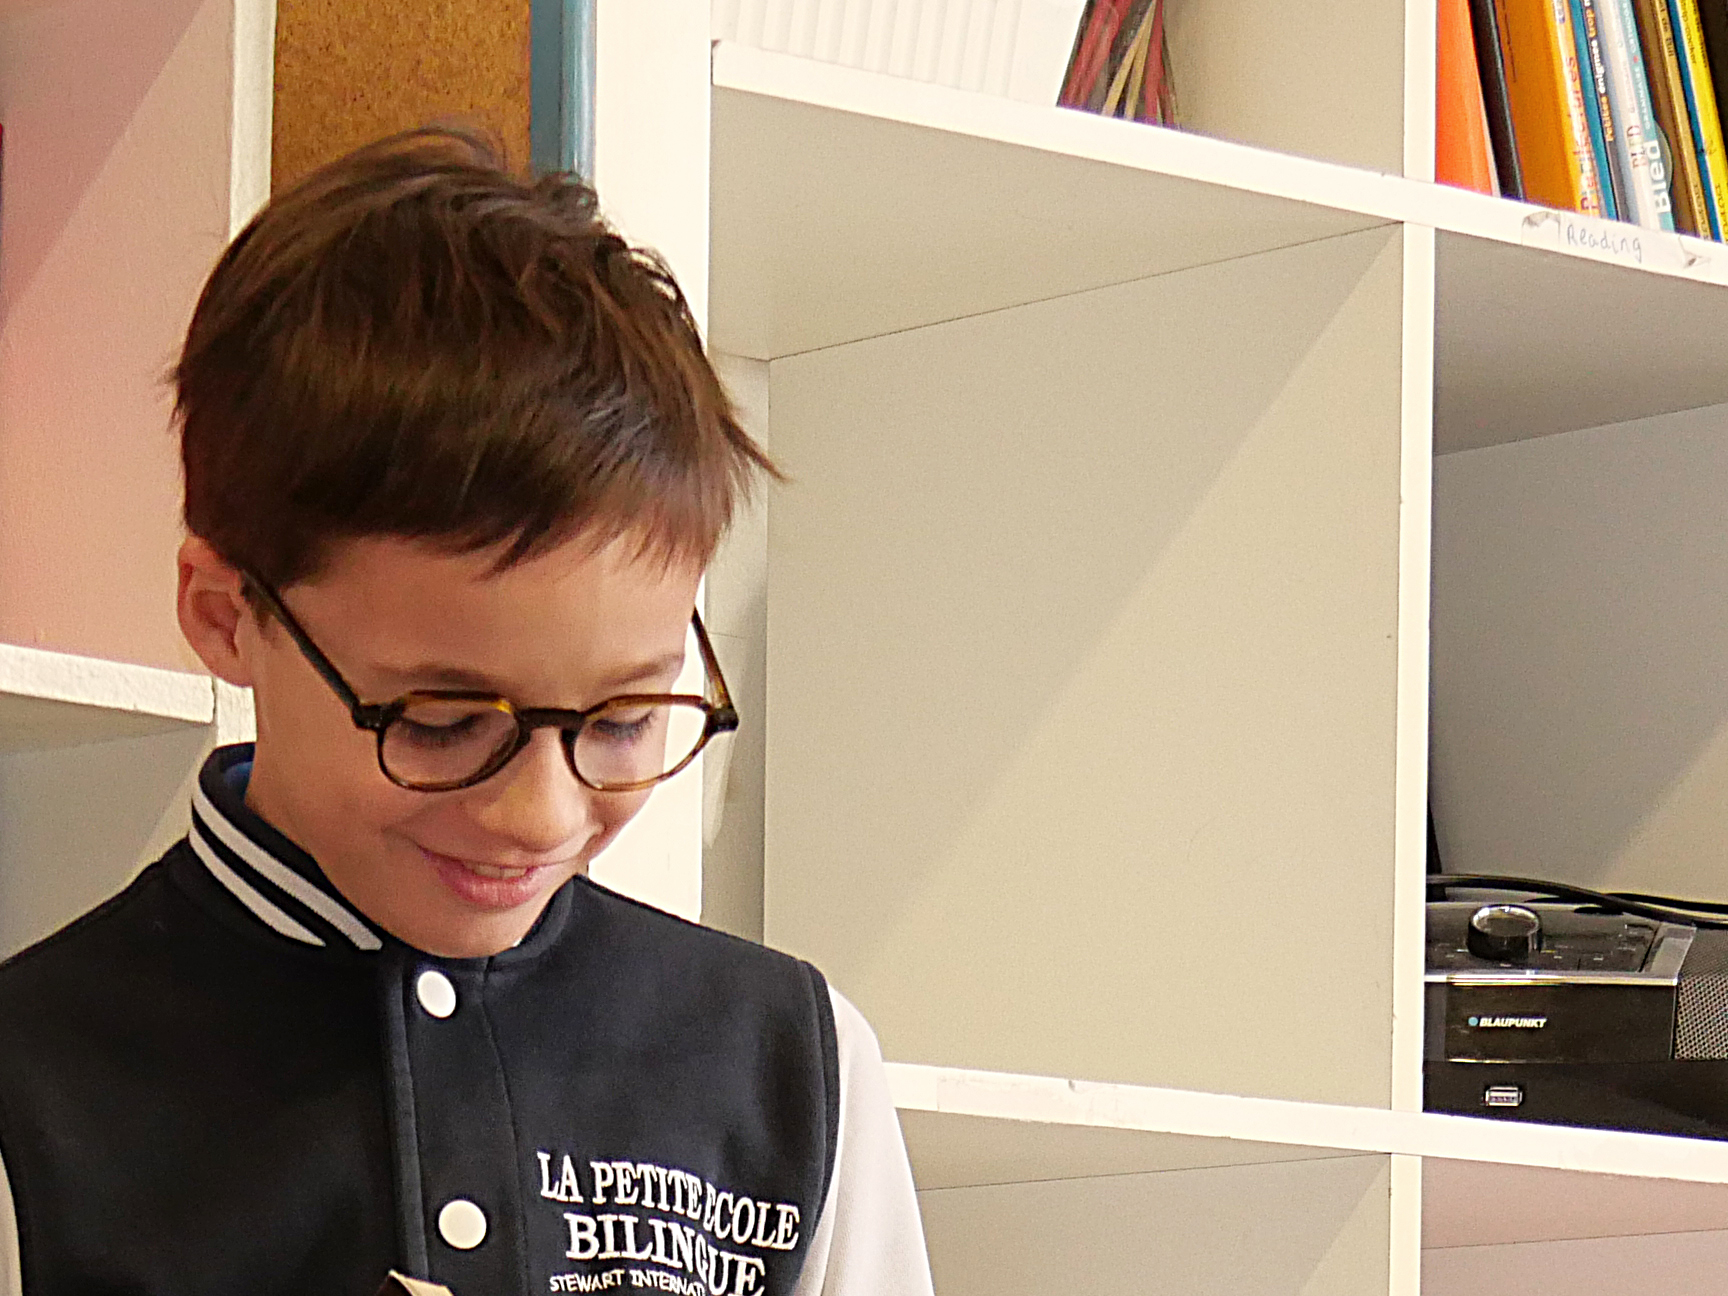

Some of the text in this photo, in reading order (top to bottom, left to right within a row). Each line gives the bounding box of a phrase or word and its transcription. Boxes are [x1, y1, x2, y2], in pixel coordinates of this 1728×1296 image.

[1647, 140, 1671, 214] Bled
[1567, 224, 1642, 263] Reading
[1479, 1017, 1546, 1029] BLAUPUNKT
[537, 1151, 583, 1203] LA
[590, 1162, 704, 1220] PETITE
[549, 1269, 624, 1292] STEWART
